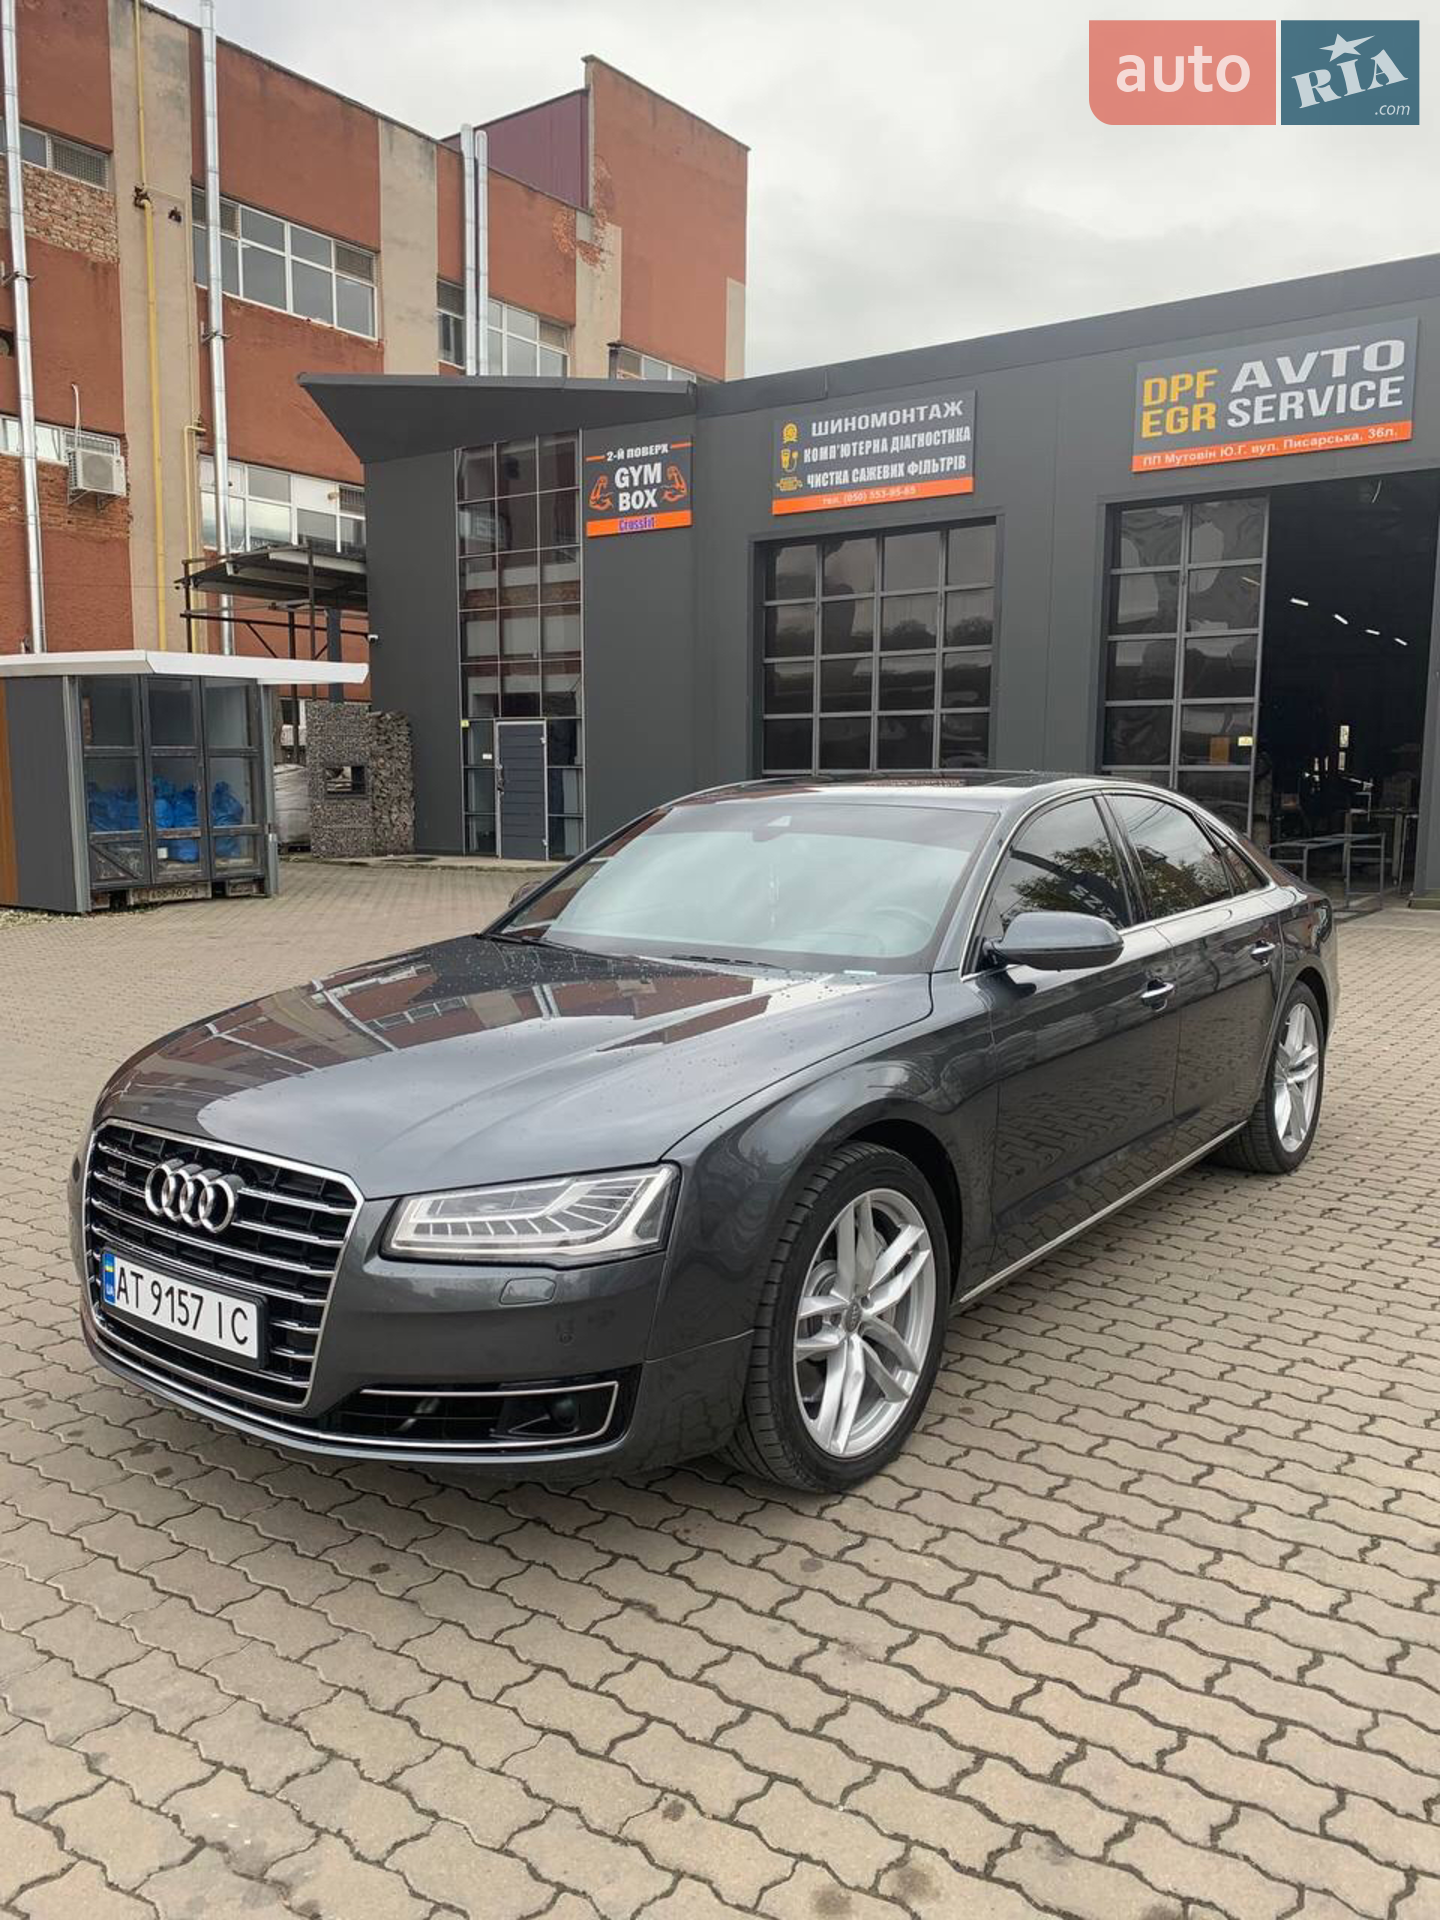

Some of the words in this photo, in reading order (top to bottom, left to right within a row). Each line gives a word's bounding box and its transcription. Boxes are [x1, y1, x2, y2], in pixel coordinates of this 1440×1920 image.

[1230, 339, 1405, 393] AVTO
[1143, 369, 1218, 407] DPF
[1227, 376, 1405, 428] SERVICE
[811, 400, 963, 438] ШИНОМОНТАЖ
[1141, 402, 1217, 439] EGR
[626, 443, 669, 459] ПОВЕРХ
[890, 426, 971, 453] ДІАГНОСТИКА
[615, 462, 662, 489] GYM
[807, 469, 850, 489] ЧИСТКА
[851, 462, 906, 484] САЖЕВИХ
[907, 454, 967, 476] ФІЛЬТРІВ
[1143, 455, 1161, 467] ПП
[619, 488, 658, 512] BOX
[117, 1266, 144, 1309] AT
[151, 1280, 204, 1331] 9157
[217, 1301, 248, 1345] IC
